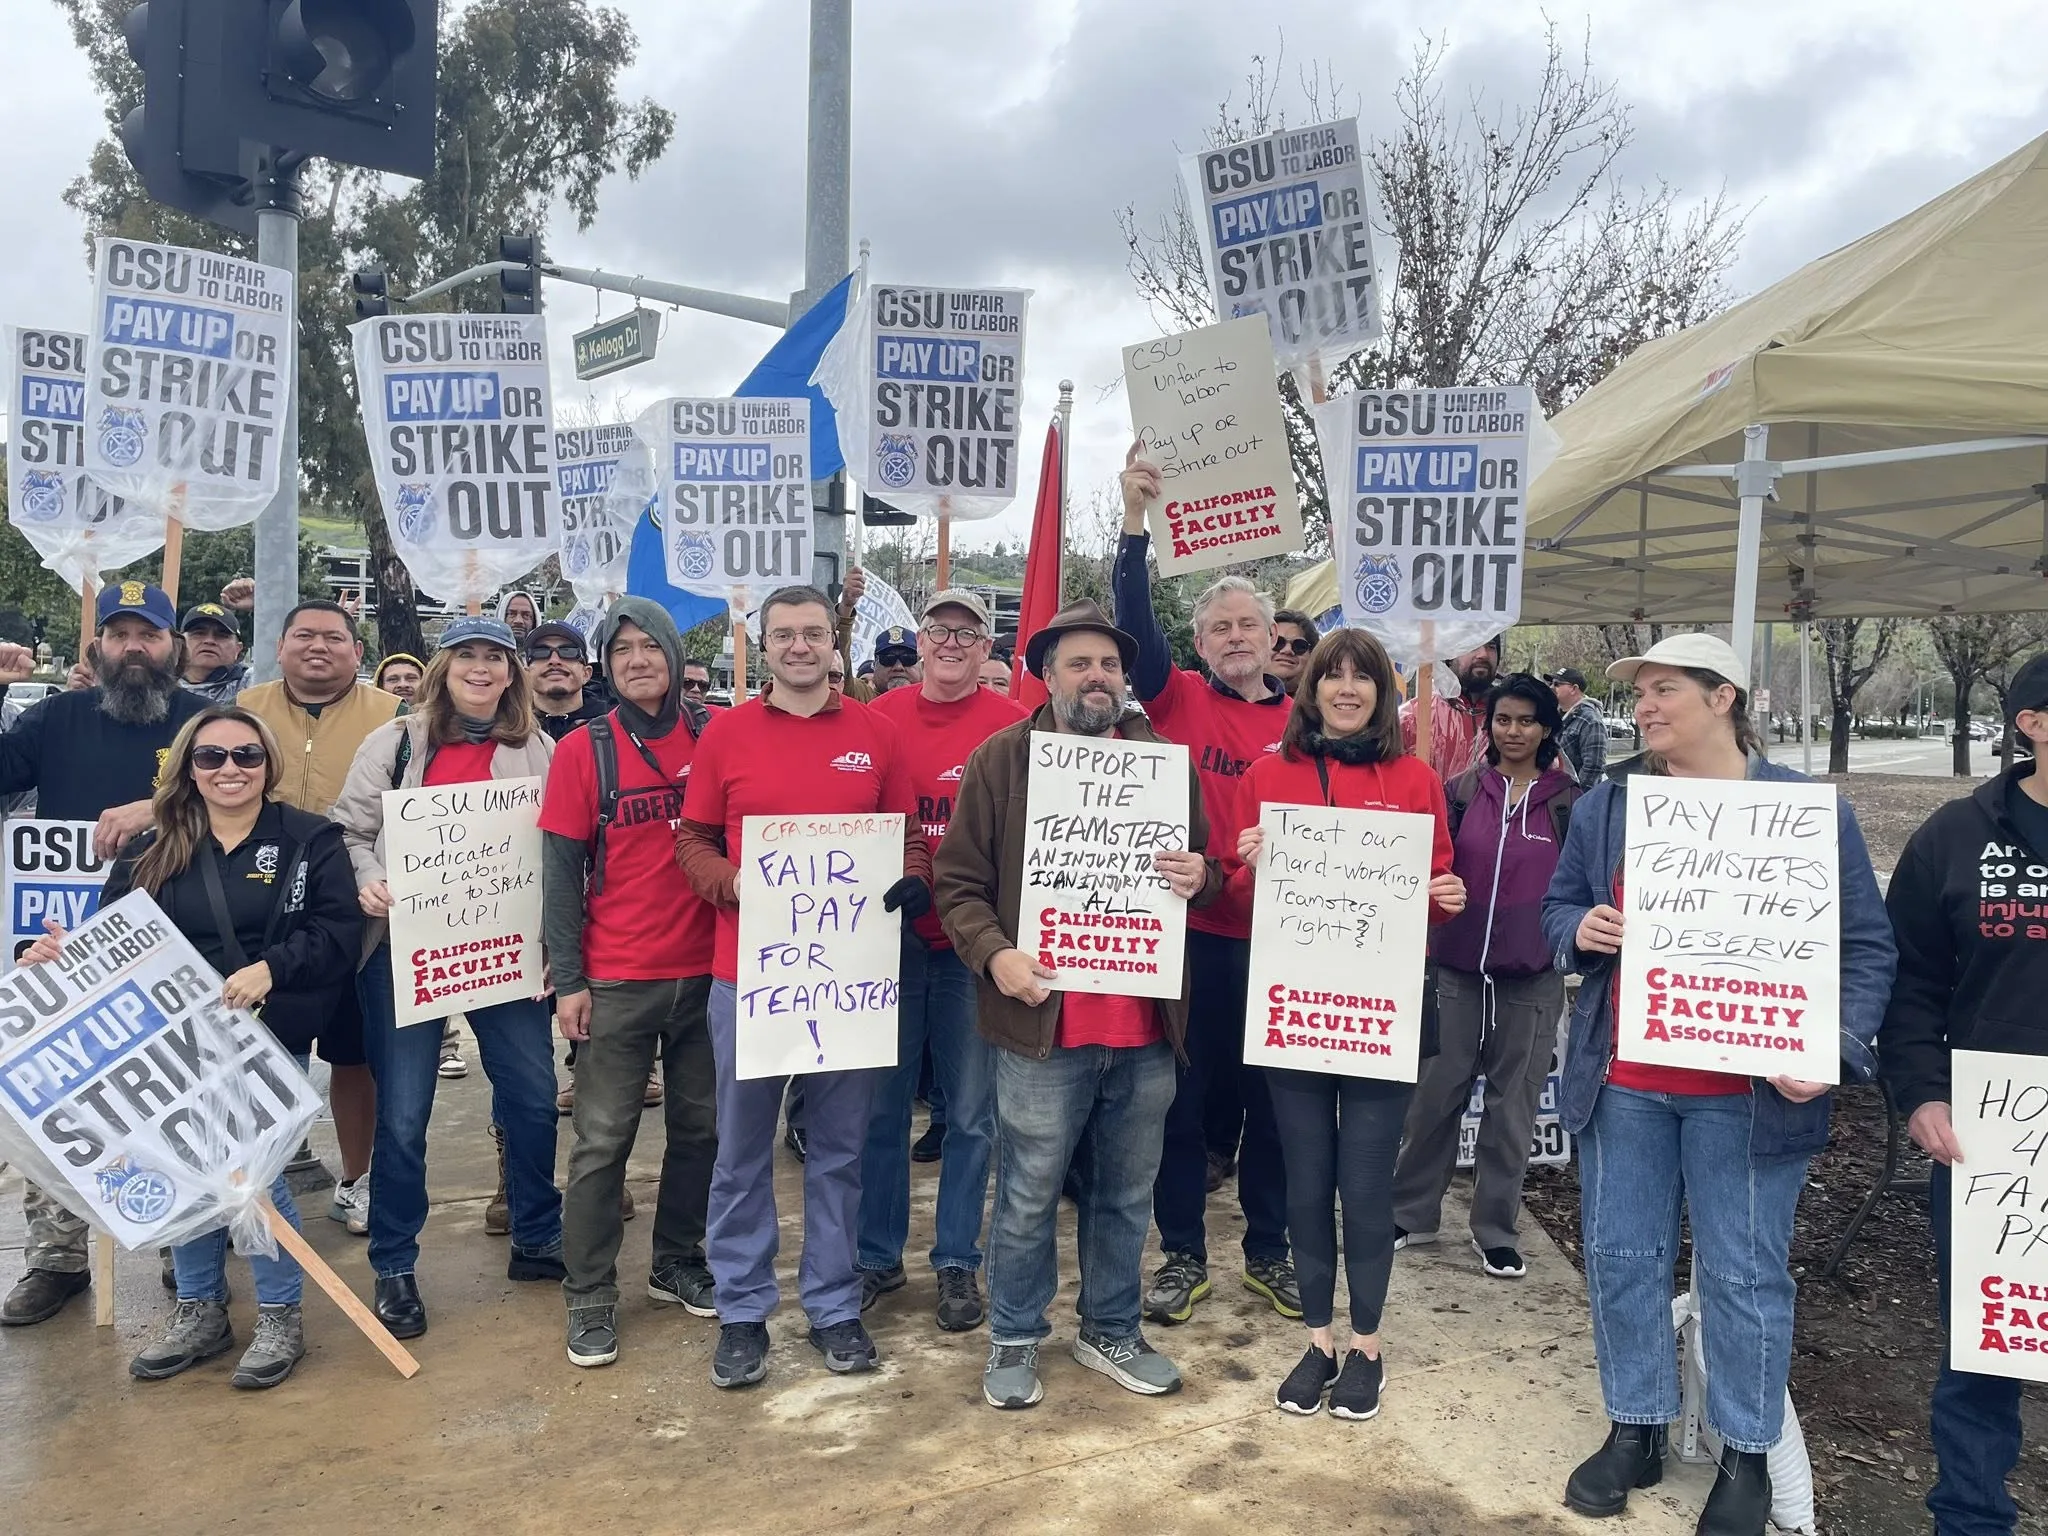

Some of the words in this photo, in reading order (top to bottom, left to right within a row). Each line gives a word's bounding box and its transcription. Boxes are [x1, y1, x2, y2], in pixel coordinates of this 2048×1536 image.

[1279, 128, 1336, 156] UNFAIR
[1281, 159, 1300, 176] TO
[1306, 145, 1356, 170] LABOR
[1206, 140, 1276, 194] CSU
[1219, 198, 1269, 240] PAY
[1276, 188, 1315, 226] UP
[1322, 188, 1360, 220] OR
[108, 244, 191, 294] CSU
[200, 258, 265, 288] UNFAIR
[1220, 222, 1368, 296] STRIKE
[198, 278, 218, 298] TO
[224, 287, 282, 312] LABOR
[877, 289, 944, 328] CSU
[951, 294, 1003, 312] UNFAIR
[1278, 275, 1372, 344] OUT
[111, 303, 172, 341] PAY
[181, 313, 228, 349] UP
[236, 331, 276, 365] OR
[459, 320, 522, 339] UNFAIR
[951, 313, 968, 330] TO
[972, 314, 1018, 332] LABOR
[380, 320, 452, 363] CSU
[460, 342, 480, 360] TO
[486, 342, 542, 360] LABOR
[589, 335, 624, 360] Kellogg
[625, 326, 638, 348] Dr
[1132, 340, 1183, 370] CSU
[884, 342, 933, 373] PAY
[940, 344, 975, 375] UP
[982, 354, 1014, 382] OR
[1215, 356, 1237, 372] to
[101, 348, 276, 420] STRIKE
[391, 380, 448, 414] PAY
[451, 378, 494, 413] UP
[504, 387, 542, 417] OR
[1178, 384, 1230, 406] labor
[1444, 392, 1506, 412] UNFAIR
[674, 402, 736, 434] CSU
[742, 403, 790, 418] UNFAIR
[877, 382, 1014, 432] STRIKE
[1359, 394, 1436, 436] CSU
[1444, 414, 1462, 434] TO
[1468, 413, 1524, 433] LABOR
[555, 430, 594, 460] CSU
[596, 427, 632, 440] UNFAIR
[742, 420, 758, 434] TO
[762, 419, 805, 434] LABOR
[1139, 426, 1178, 460] Pay
[156, 412, 273, 480] OUT
[390, 424, 548, 476] STRIKE
[597, 441, 609, 454] TO
[680, 448, 728, 475] PAY
[733, 448, 766, 475] UP
[773, 454, 802, 478] OR
[926, 435, 1014, 488] OUT
[562, 466, 590, 492] PAY
[1364, 452, 1422, 486] PAY
[1429, 452, 1472, 486] UP
[1480, 458, 1518, 490] OR
[448, 481, 552, 540] OUT
[675, 484, 805, 524] STRIKE
[1356, 496, 1518, 546] STRIKE
[724, 530, 806, 576] OUT
[1412, 552, 1516, 612] OUT
[846, 752, 871, 765] CFA
[1038, 742, 1166, 780] SUPPORT
[401, 792, 475, 822] CSU
[484, 785, 540, 812] UNFAIR
[1078, 782, 1144, 807] THE
[427, 823, 466, 845] TO
[762, 822, 802, 842] CFA
[806, 818, 902, 837] SOLIDARITY
[921, 824, 946, 836] THE
[1034, 814, 1186, 851] TEAMSTERS
[1271, 809, 1346, 844] Treat
[1362, 832, 1407, 848] our
[1644, 794, 1724, 840] PAY
[1738, 802, 1832, 838] THE
[13, 826, 103, 872] CSU
[404, 835, 511, 873] Dedicated
[1059, 851, 1130, 873] INJURY
[1628, 842, 1830, 890] TEAMSTERS
[758, 850, 859, 887] FAIR
[1146, 876, 1170, 890] TO
[1980, 864, 2016, 878] to
[401, 893, 449, 914] Time
[466, 885, 482, 900] to
[1083, 890, 1152, 914] ALL
[1271, 879, 1378, 918] Teamsters
[1638, 887, 1719, 912] WHAT
[1734, 892, 1831, 922] THEY
[1980, 881, 2007, 898] is
[22, 890, 89, 927] PAY
[791, 893, 867, 936] PAY
[57, 912, 132, 972] UNFAIR
[1649, 924, 1829, 960] DESERVE
[1979, 922, 2014, 937] to
[68, 965, 100, 992] TO
[102, 920, 169, 973] LABOR
[758, 943, 834, 972] FOR
[0, 962, 69, 1040] SU
[741, 978, 899, 1018] TEAMSTERS
[6, 1028, 93, 1107] PAY
[100, 991, 146, 1050] UP
[151, 964, 211, 1015] OR
[806, 1020, 824, 1064] !
[42, 997, 256, 1168] STRIKE
[2012, 1130, 2048, 1166] 4
